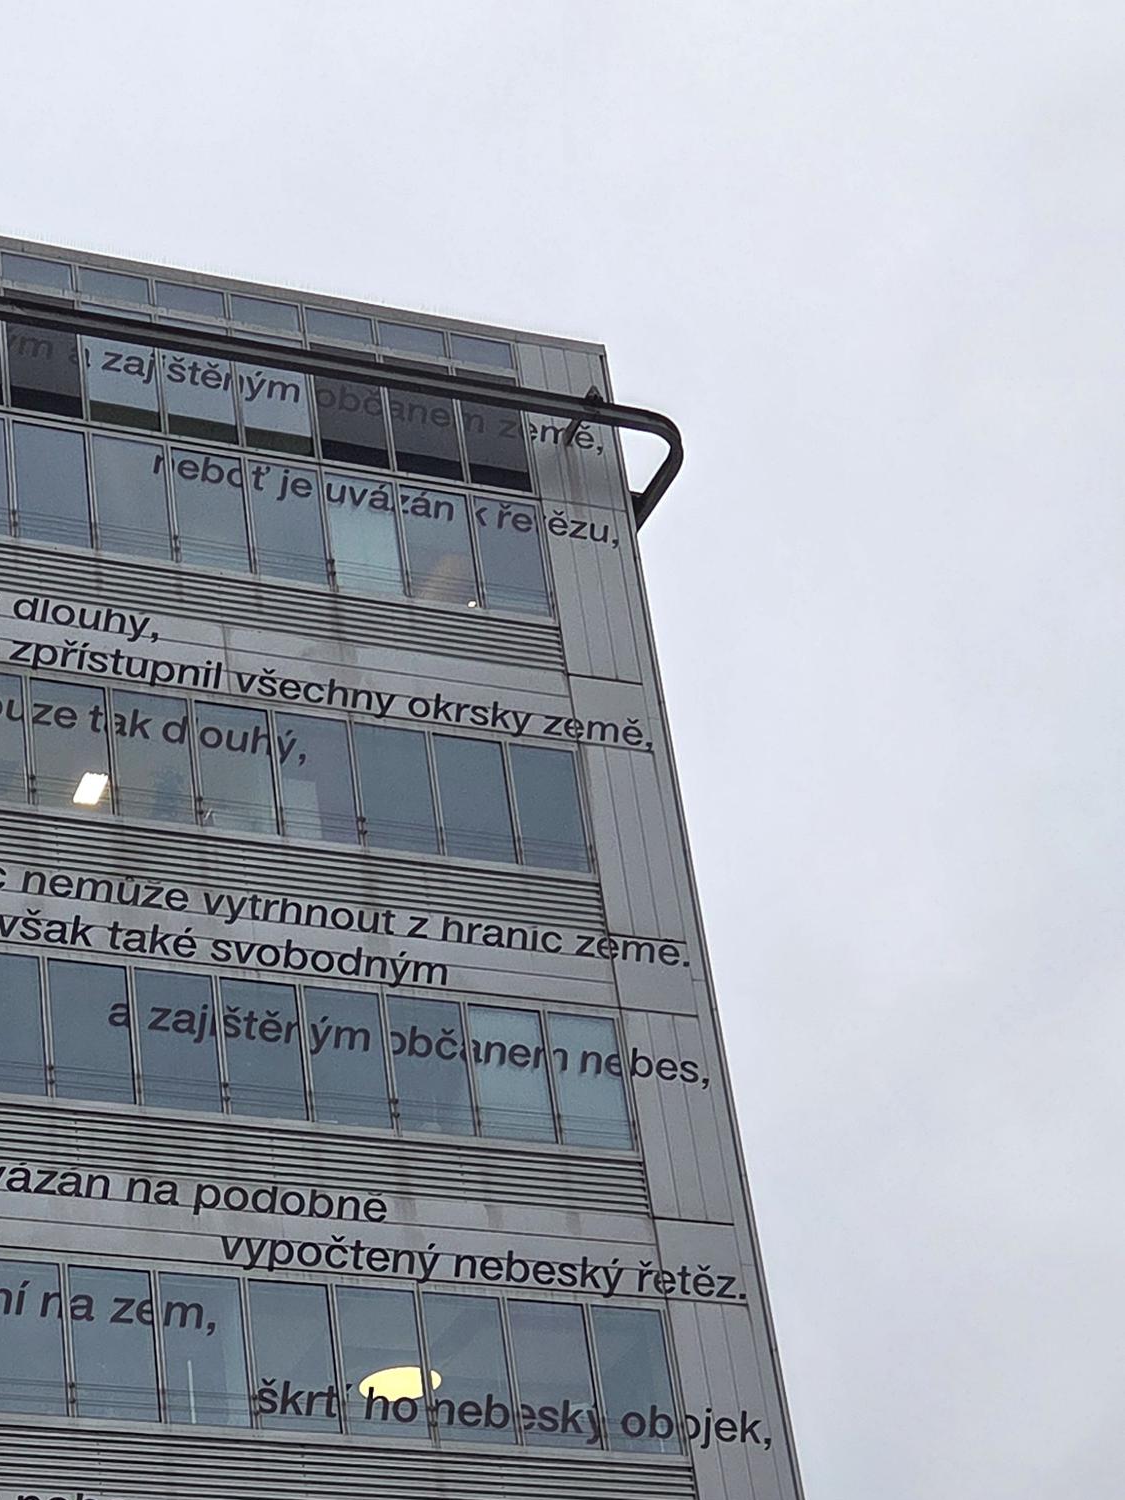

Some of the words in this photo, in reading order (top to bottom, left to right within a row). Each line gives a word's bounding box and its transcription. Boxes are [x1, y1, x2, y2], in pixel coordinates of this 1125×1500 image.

[101, 351, 301, 404] zajštěným
[277, 469, 313, 501] je
[325, 480, 455, 523] uvázán
[496, 503, 620, 550] řeězu,
[8, 638, 224, 689] zpřístupnil
[236, 667, 395, 720] všechny
[407, 692, 532, 738] okrsky
[543, 713, 655, 753] země,
[89, 702, 151, 740] tak
[161, 714, 308, 768] douhý,
[107, 920, 198, 960] také
[210, 939, 450, 988] svobodným
[203, 891, 396, 937] vytrhnout
[406, 915, 429, 940] z
[441, 914, 564, 956] hranic
[108, 1001, 132, 1029] a
[580, 1046, 711, 1091] nebes,
[126, 1175, 180, 1207] na
[192, 1181, 388, 1225] podobně
[221, 1233, 442, 1285] vypočtený
[454, 1249, 625, 1299] nebeský
[638, 1259, 748, 1301] řetěz.
[40, 1290, 94, 1322] na
[109, 1296, 217, 1337] zem,
[365, 1385, 419, 1424] ho
[434, 1392, 602, 1445] nebeský
[621, 1404, 773, 1452] obojek,
